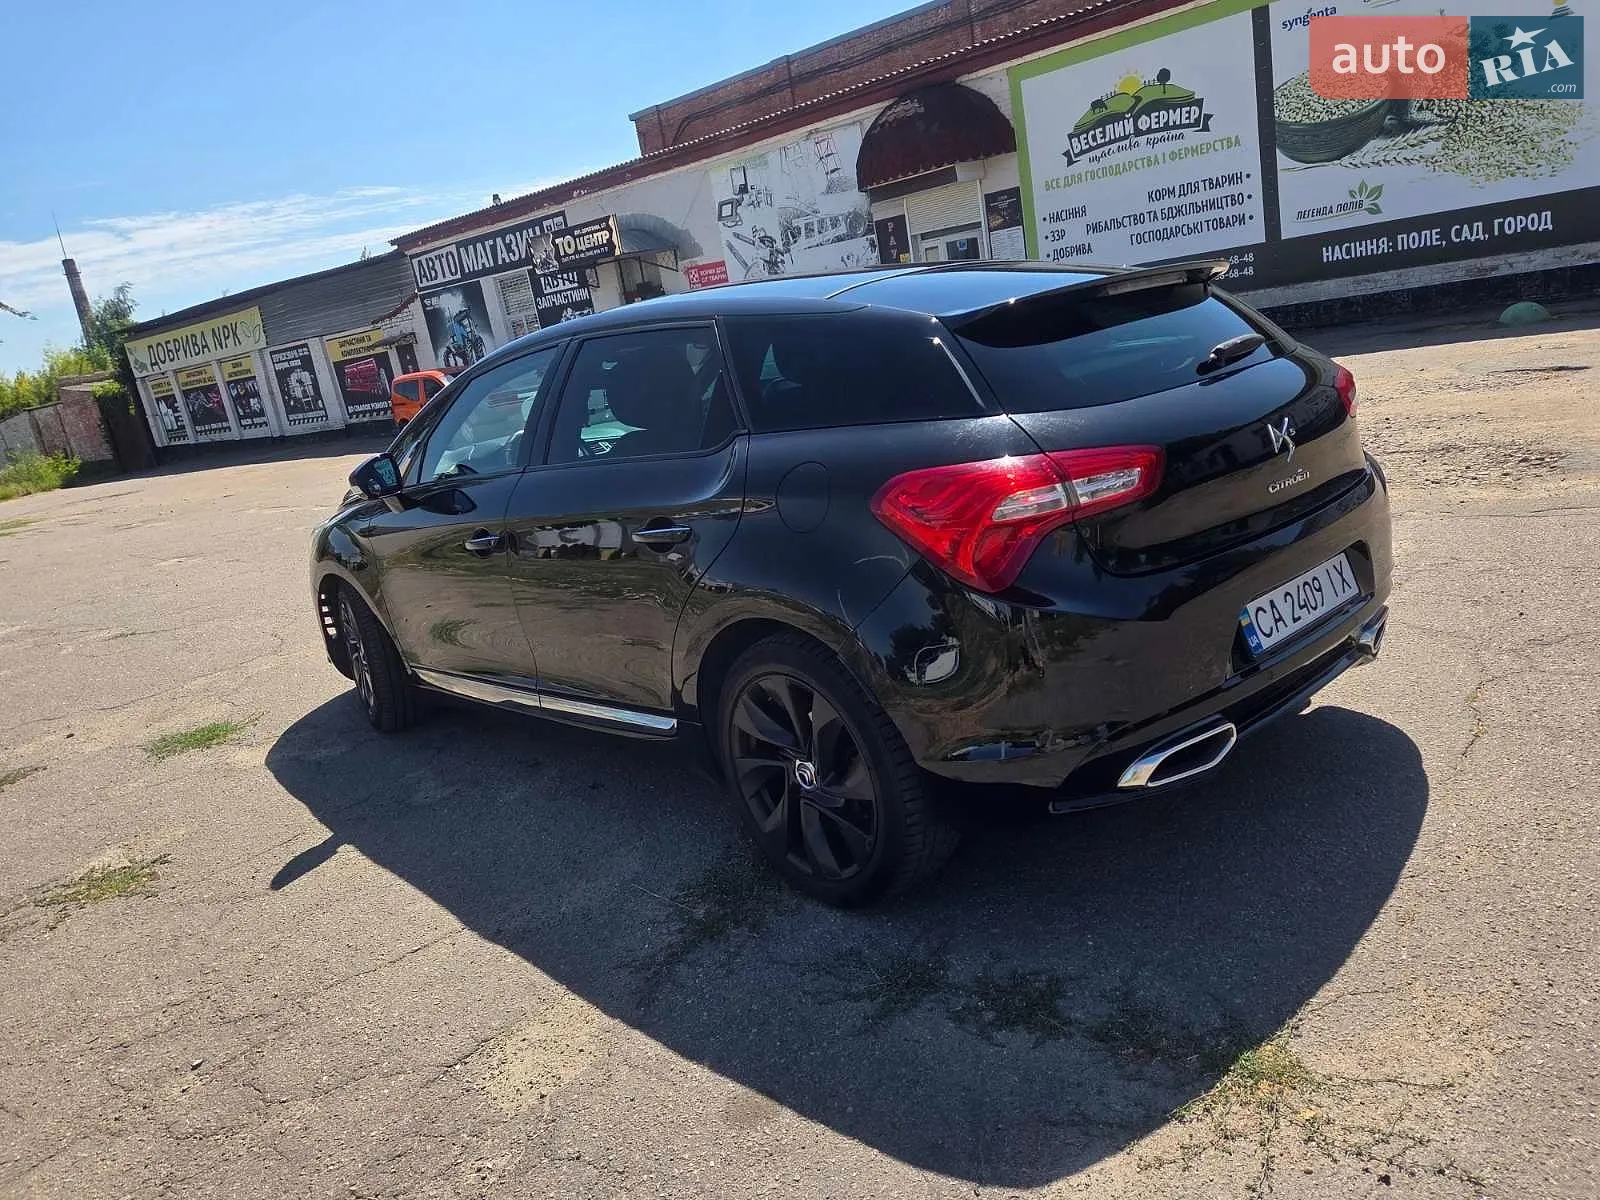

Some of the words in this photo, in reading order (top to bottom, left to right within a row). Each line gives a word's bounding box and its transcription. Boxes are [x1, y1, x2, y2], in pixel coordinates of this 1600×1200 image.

[1281, 5, 1337, 31] syngenta
[1070, 113, 1135, 154] ВЕСЕЛИЙ
[1137, 105, 1200, 132] ФЕРМЕР
[1044, 178, 1061, 192] ВСЕ
[1063, 174, 1083, 190] ДЛЯ
[1084, 156, 1160, 184] ГОСПОДАРСТВА
[1168, 135, 1242, 163] ФЕРМЕРСТВА
[1087, 138, 1140, 164] щаслива
[1145, 130, 1185, 151] країна
[1147, 184, 1176, 204] КОРМ
[1178, 179, 1201, 200] ДЛЯ
[1201, 171, 1243, 194] ТВАРИН
[1048, 204, 1087, 225] НАСІННЯ
[1086, 212, 1146, 236] РИБАЛЬСТВО
[1146, 209, 1159, 223] ТА
[1160, 192, 1245, 222] БДЖІЛЬНИЦТВО
[1296, 205, 1334, 221] ЛЕГЕНДА
[1336, 199, 1364, 214] ПОЛІВ
[555, 235, 576, 257] ТО
[576, 230, 610, 252] ЦЕНТР
[1130, 219, 1204, 246] ГОСПОДАРСЬКІ
[1204, 214, 1246, 234] ТОВАРИ
[1322, 236, 1394, 264] НАСІННЯ:
[1397, 228, 1447, 252] ПОЛЕ,
[1451, 222, 1489, 243] САД,
[1493, 211, 1553, 236] ГОРОД
[417, 246, 461, 285] АВТО
[1052, 242, 1093, 263] ДОБРИВА
[536, 287, 590, 310] ЗАПЧАСТИНИ
[148, 335, 213, 372] ДОБРИВА
[213, 322, 241, 349] NPK
[1255, 599, 1288, 639] CA
[1284, 576, 1325, 624] 2409
[1326, 560, 1353, 598] IX
